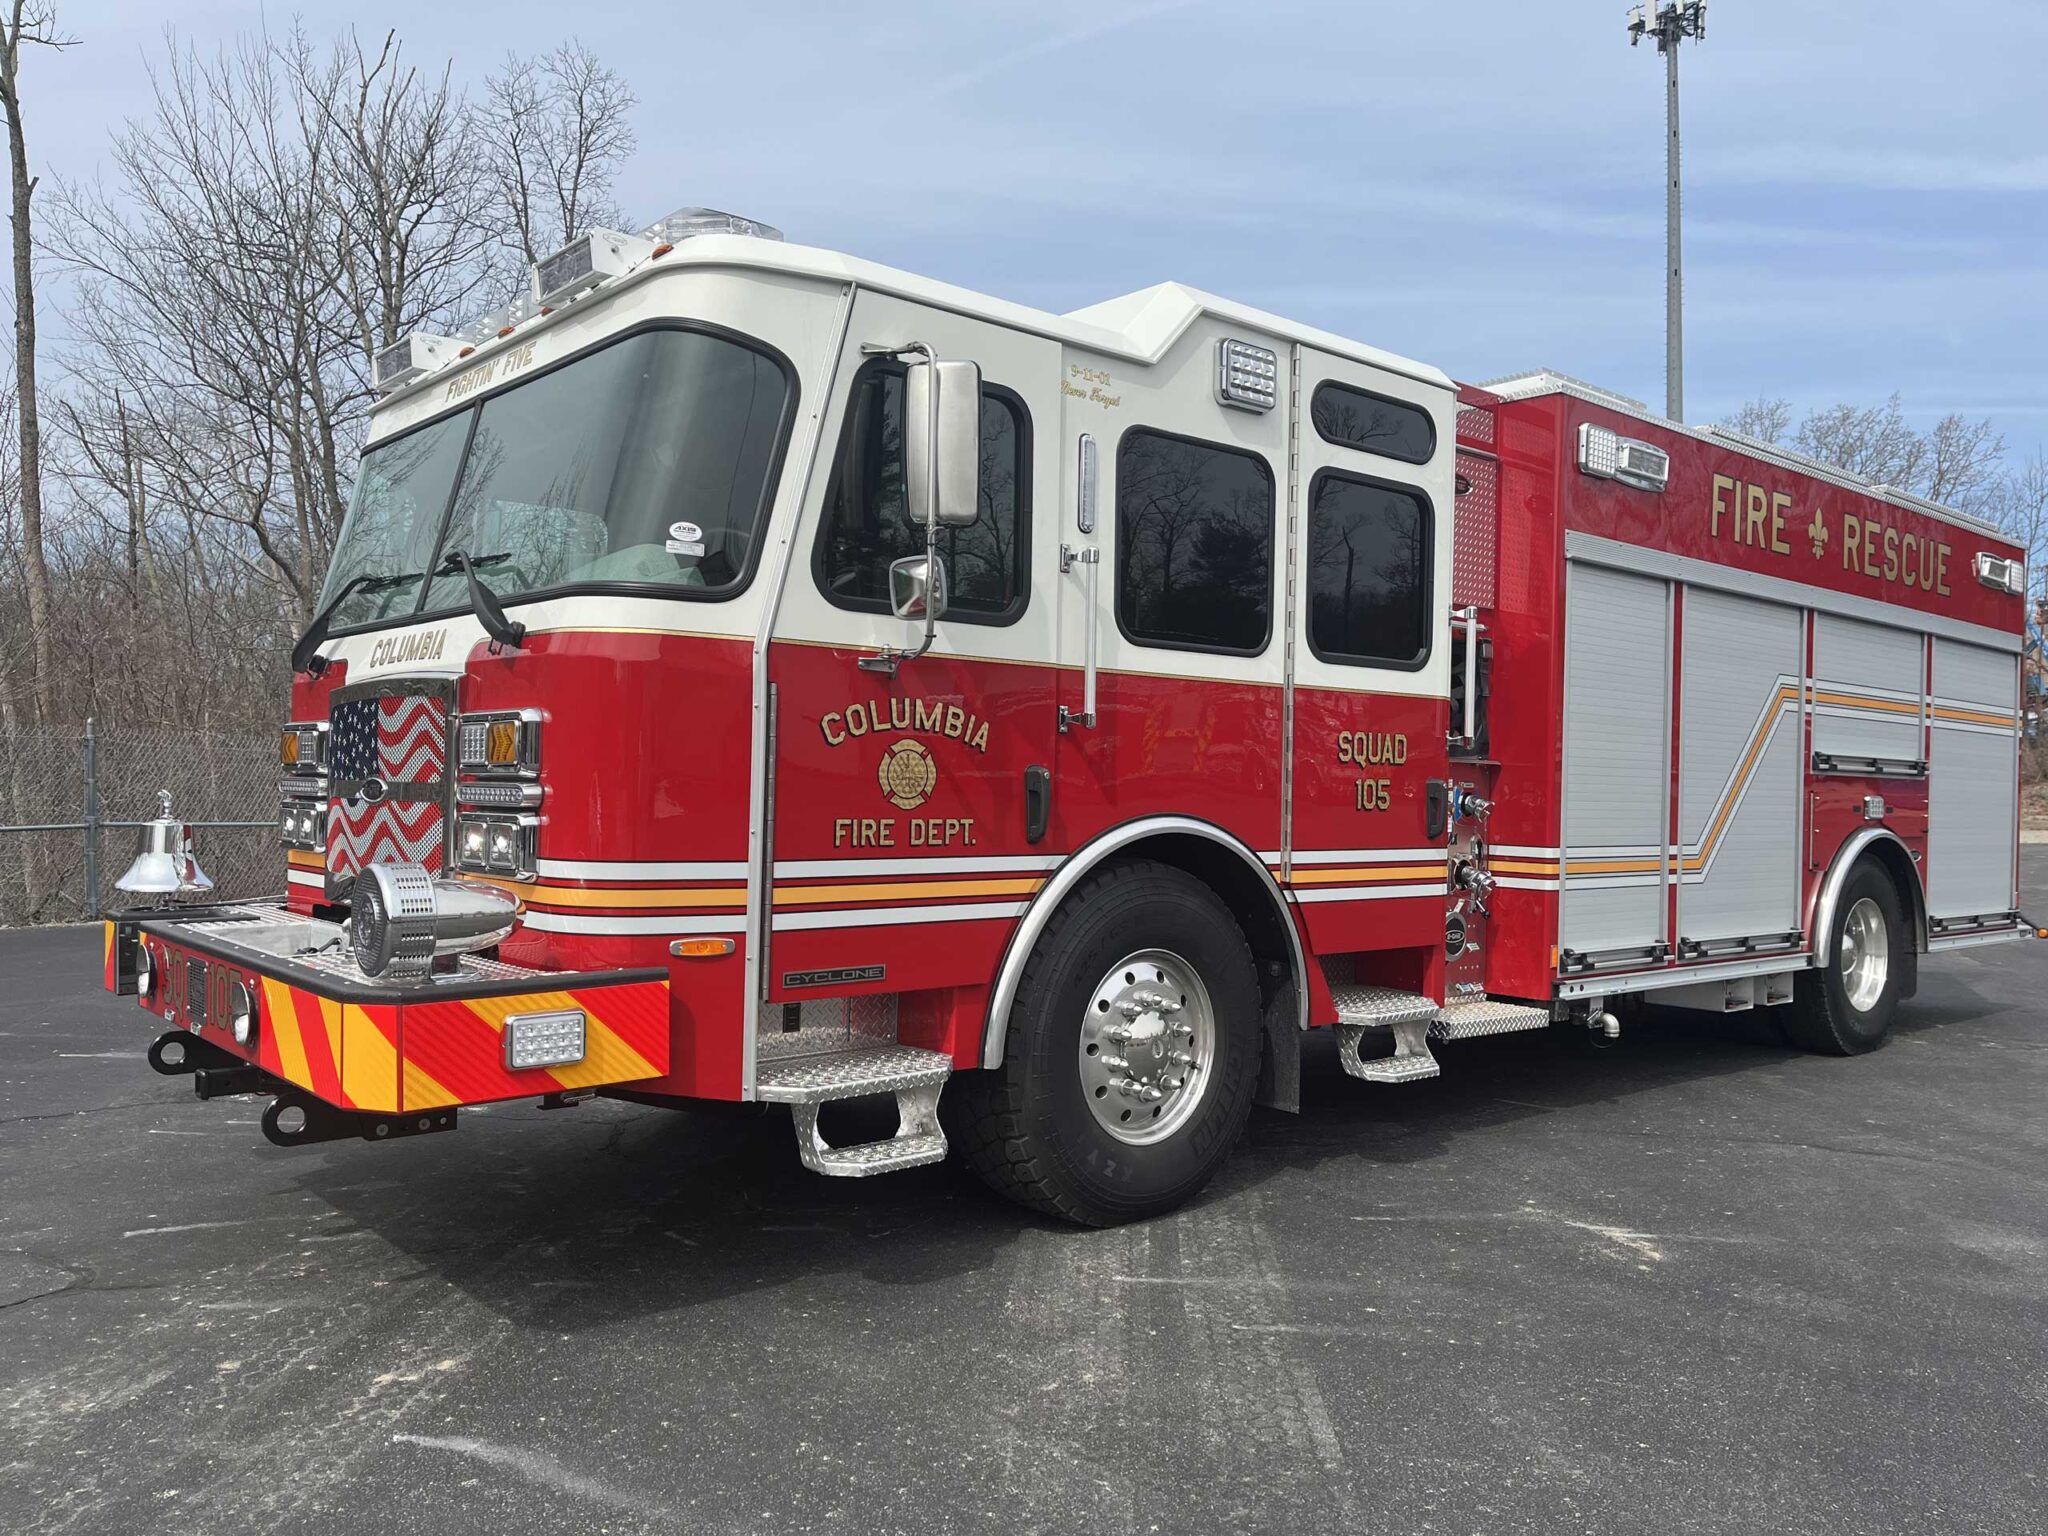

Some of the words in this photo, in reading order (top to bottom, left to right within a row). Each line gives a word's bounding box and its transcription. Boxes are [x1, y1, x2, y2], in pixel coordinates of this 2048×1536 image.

[444, 357, 501, 403] FIGHTIN'
[501, 341, 537, 376] FIVE
[1711, 473, 1792, 555] FIRE
[1842, 512, 1952, 596] RESCUE
[369, 628, 447, 668] COLUMBIA
[821, 697, 989, 752] COLUMBIA
[1337, 730, 1407, 770] SQUAD
[1354, 778, 1391, 811] 105
[833, 818, 896, 848] FIRE
[909, 818, 977, 847] DEPT.
[785, 967, 882, 985] CYCLONE
